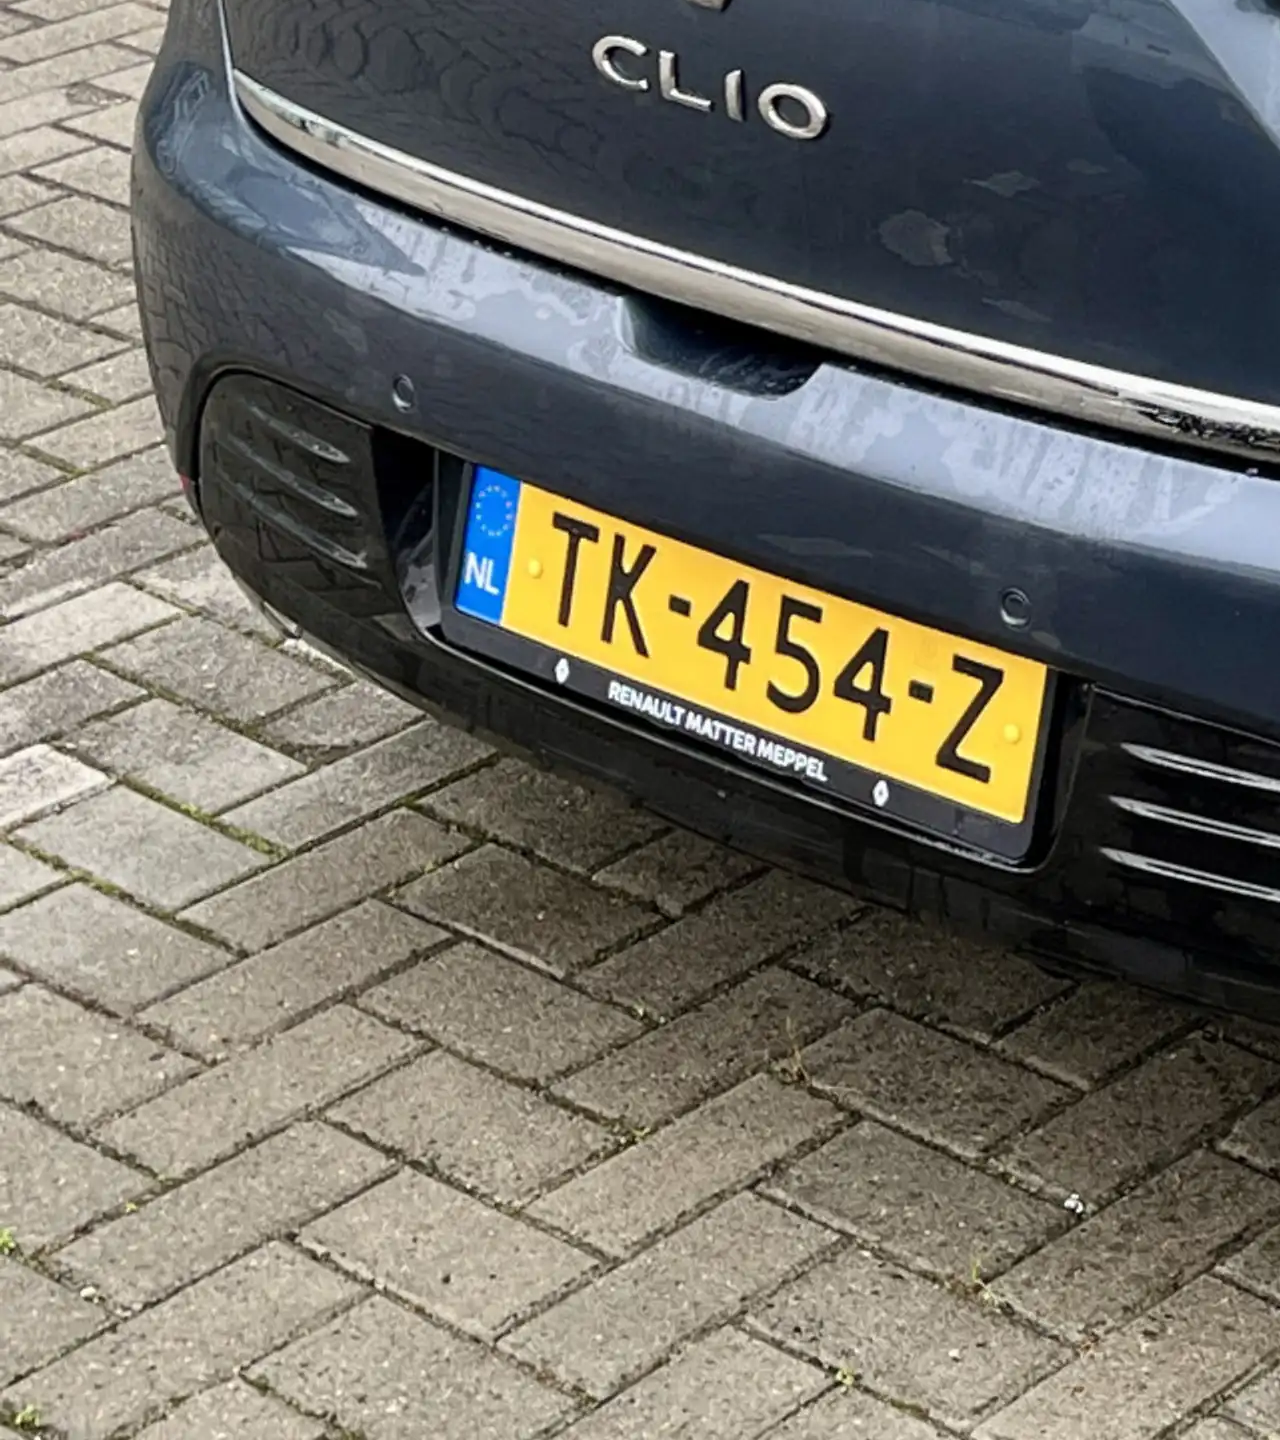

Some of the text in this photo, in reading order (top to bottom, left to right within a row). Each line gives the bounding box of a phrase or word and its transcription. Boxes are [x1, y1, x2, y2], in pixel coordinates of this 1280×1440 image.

[592, 34, 829, 140] CLIO
[464, 550, 500, 597] NL
[551, 510, 1004, 784] TK-454-Z
[607, 679, 829, 782] RENAULT MATTER MEPPEL
